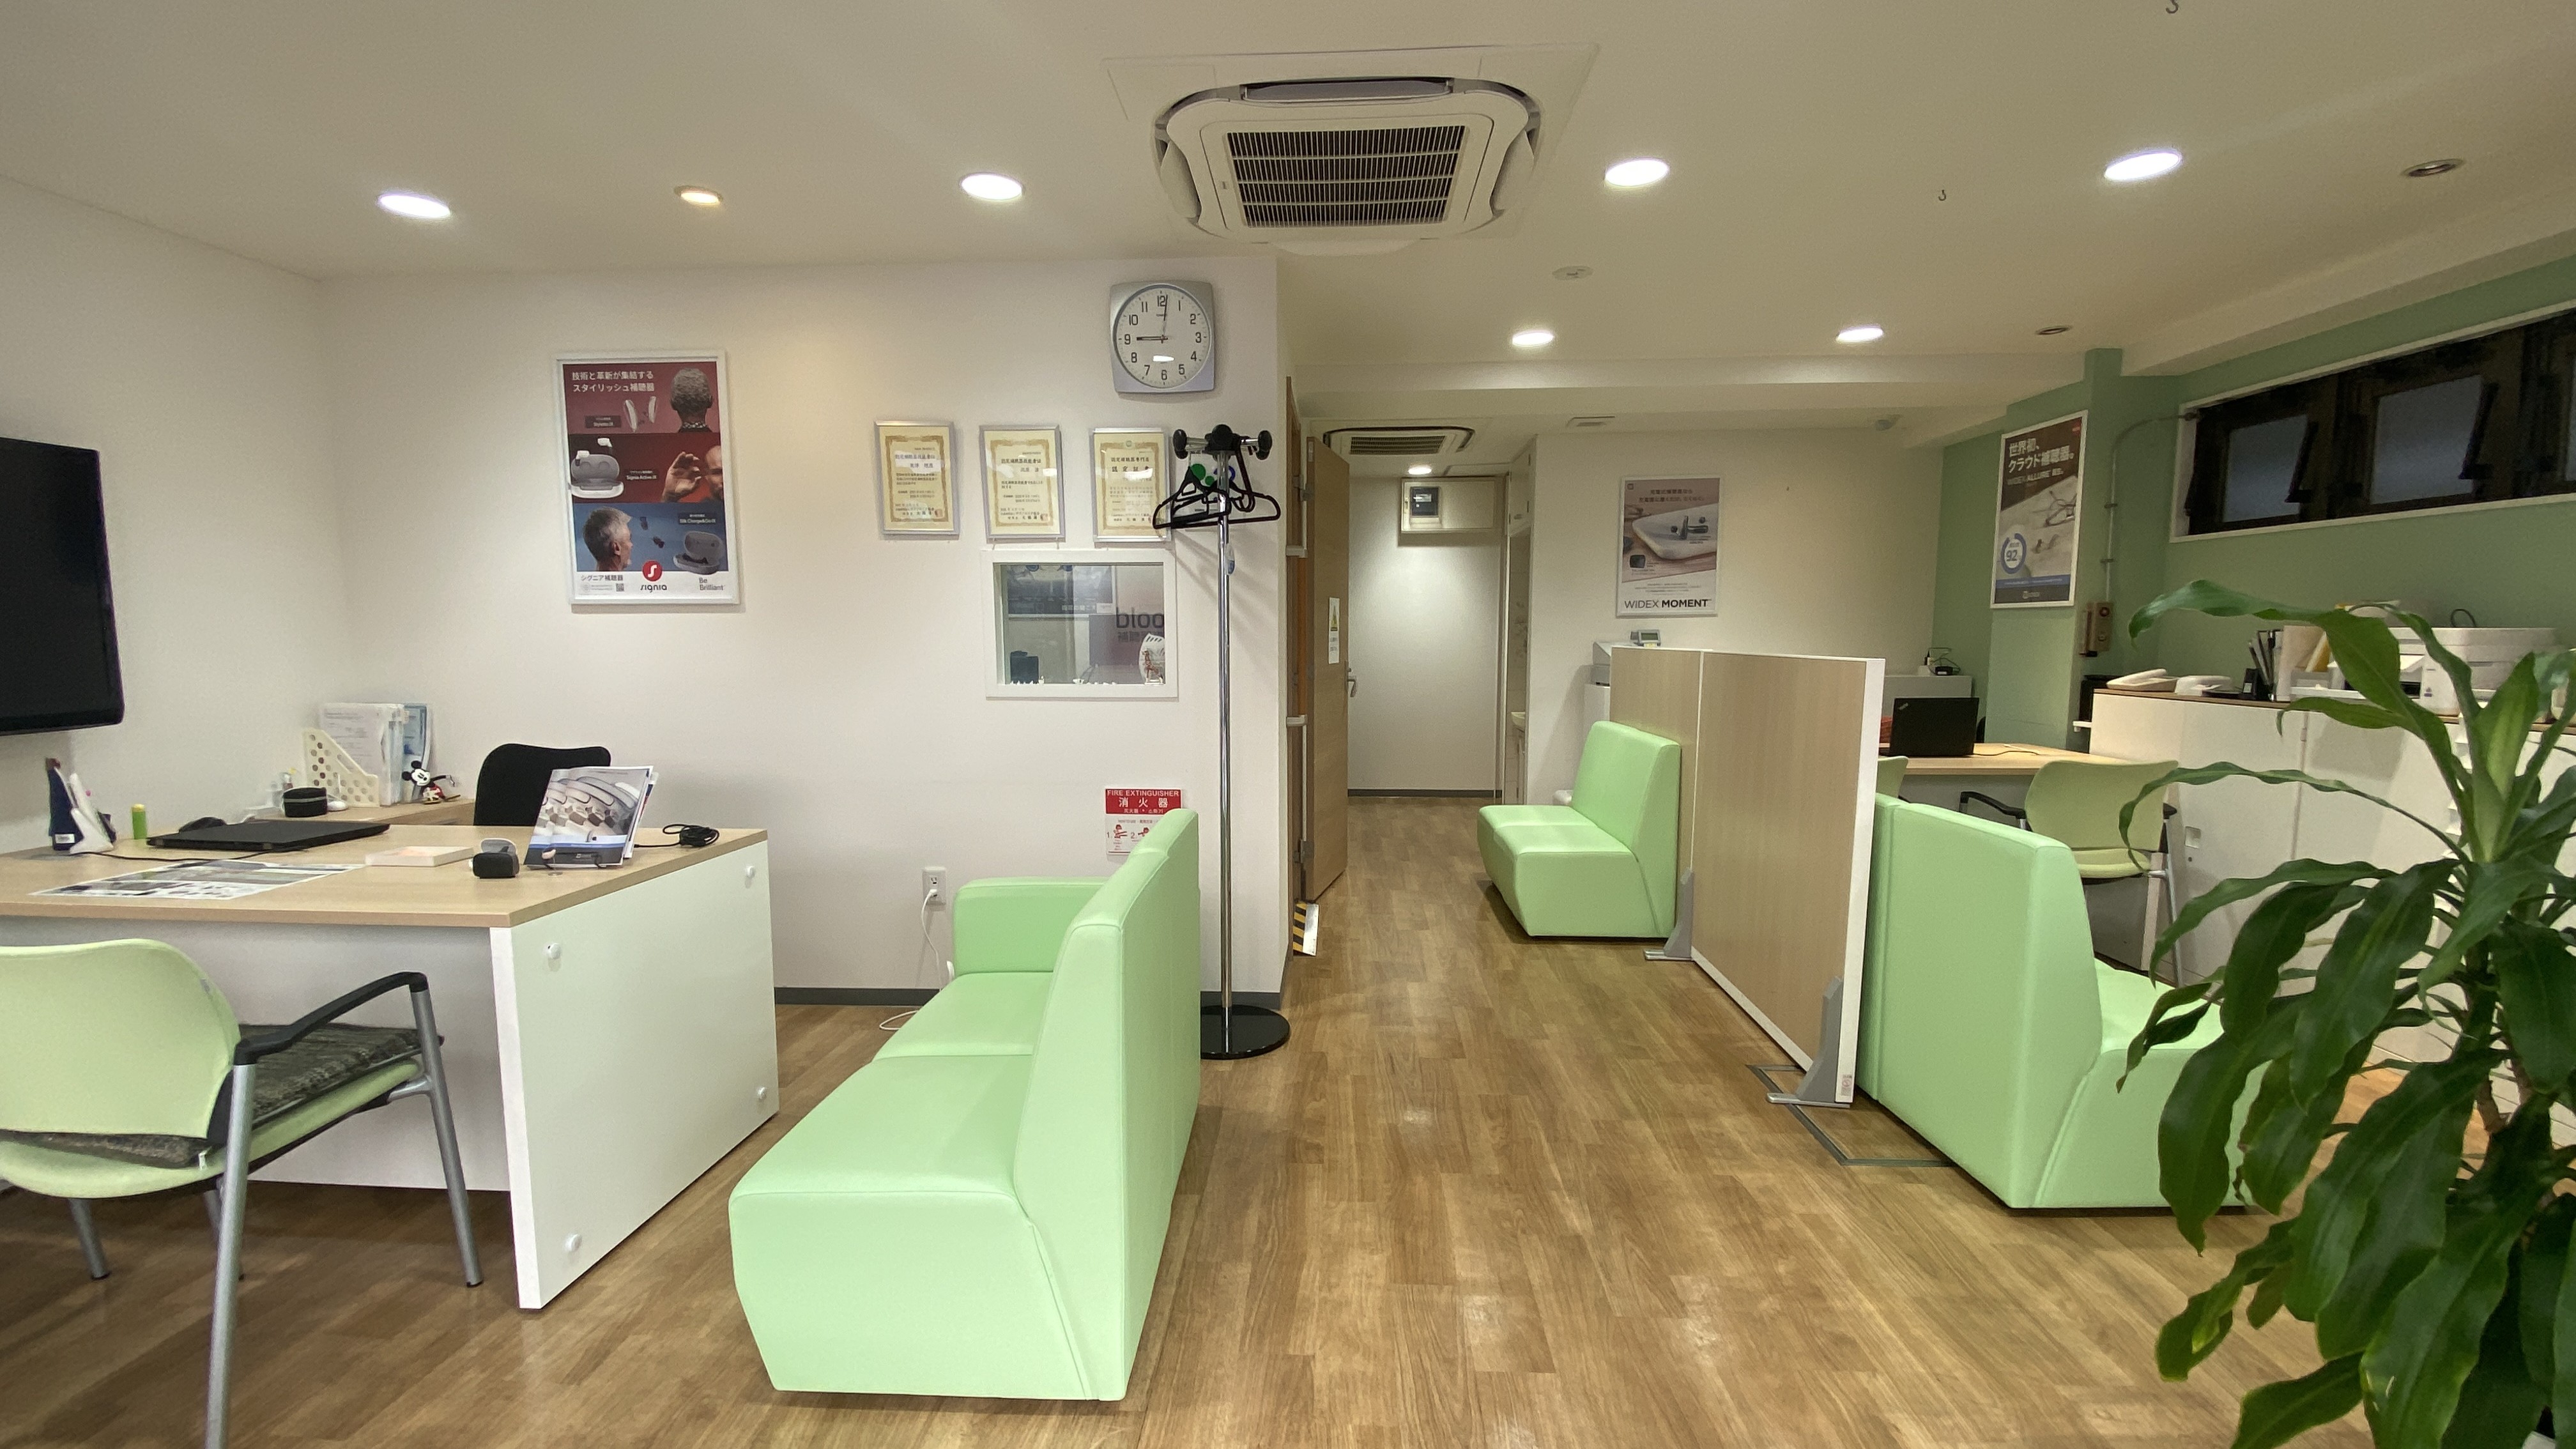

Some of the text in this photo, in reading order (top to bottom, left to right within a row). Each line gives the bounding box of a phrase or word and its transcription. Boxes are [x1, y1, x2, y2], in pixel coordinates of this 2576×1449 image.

[1157, 295, 1166, 307] 12
[1141, 301, 1148, 313] 11
[1128, 314, 1138, 326] 10
[1190, 313, 1197, 325] 2
[1124, 334, 1131, 345] 9
[1195, 332, 1202, 343] 3
[1131, 352, 1137, 363] 8
[1190, 351, 1197, 362] 4
[1144, 364, 1151, 376] 7
[1161, 369, 1168, 381] 6
[1178, 364, 1185, 375] 5
[2005, 549, 2018, 562] 92
[640, 584, 668, 594] signia
[1624, 599, 1708, 609] WIDEX MOMENT
[1119, 797, 1169, 808] 消火器
